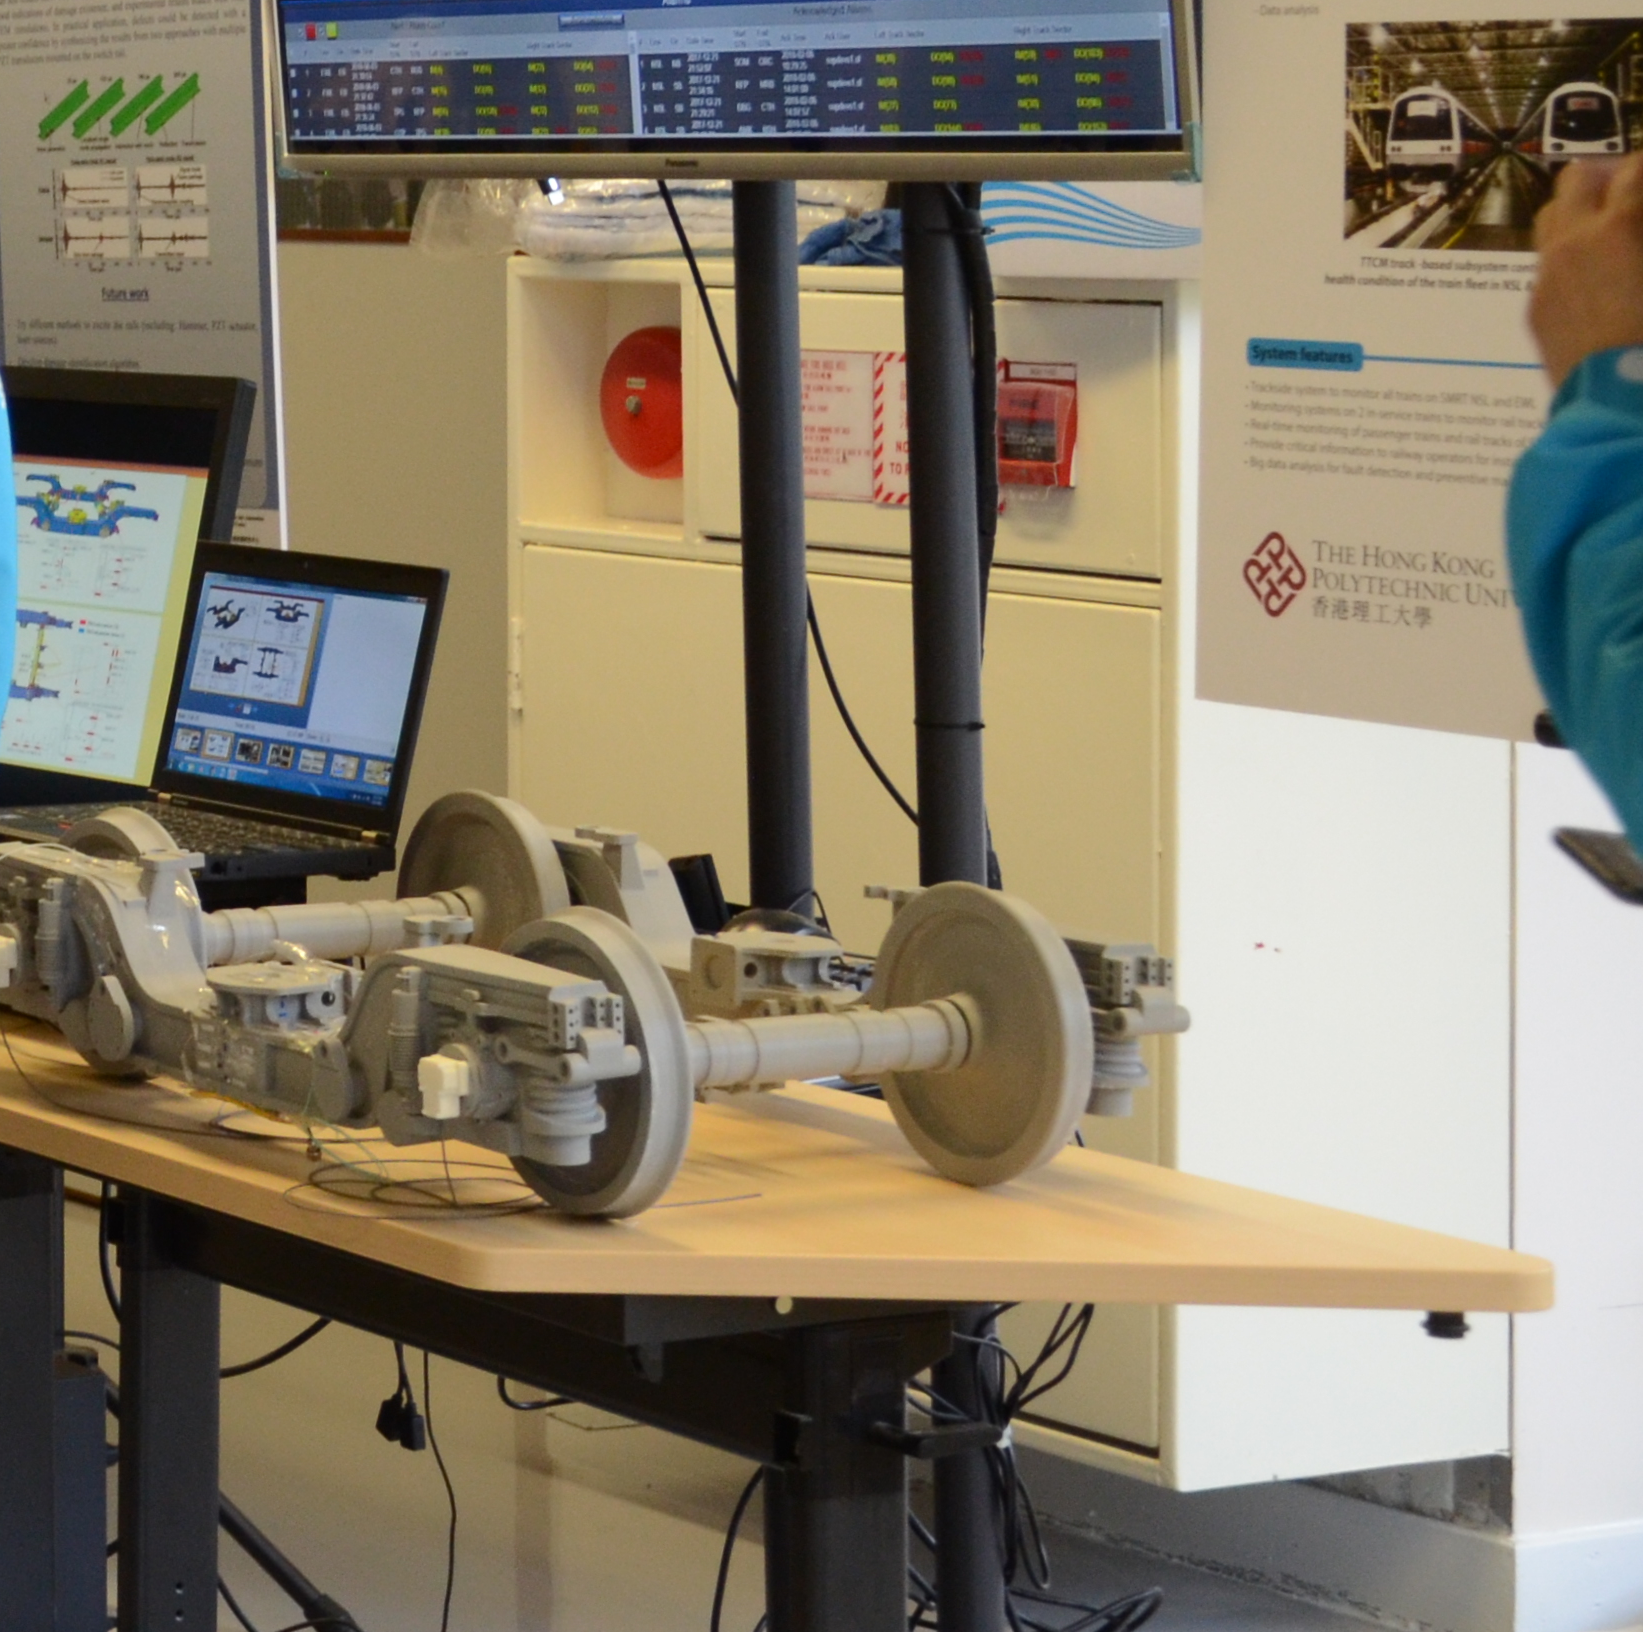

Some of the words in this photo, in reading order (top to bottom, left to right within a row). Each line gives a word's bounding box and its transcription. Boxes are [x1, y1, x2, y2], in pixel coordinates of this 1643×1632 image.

[102, 287, 127, 302] Future
[129, 287, 149, 301] work
[1252, 344, 1298, 364] System
[1301, 347, 1353, 365] features
[890, 463, 902, 475] TO
[1312, 540, 1356, 565] THE
[1362, 545, 1426, 572] HONG
[1432, 551, 1495, 579] KONG
[1312, 567, 1460, 604] POLYTECHNIC
[1313, 594, 1433, 629] 香港理工大學
